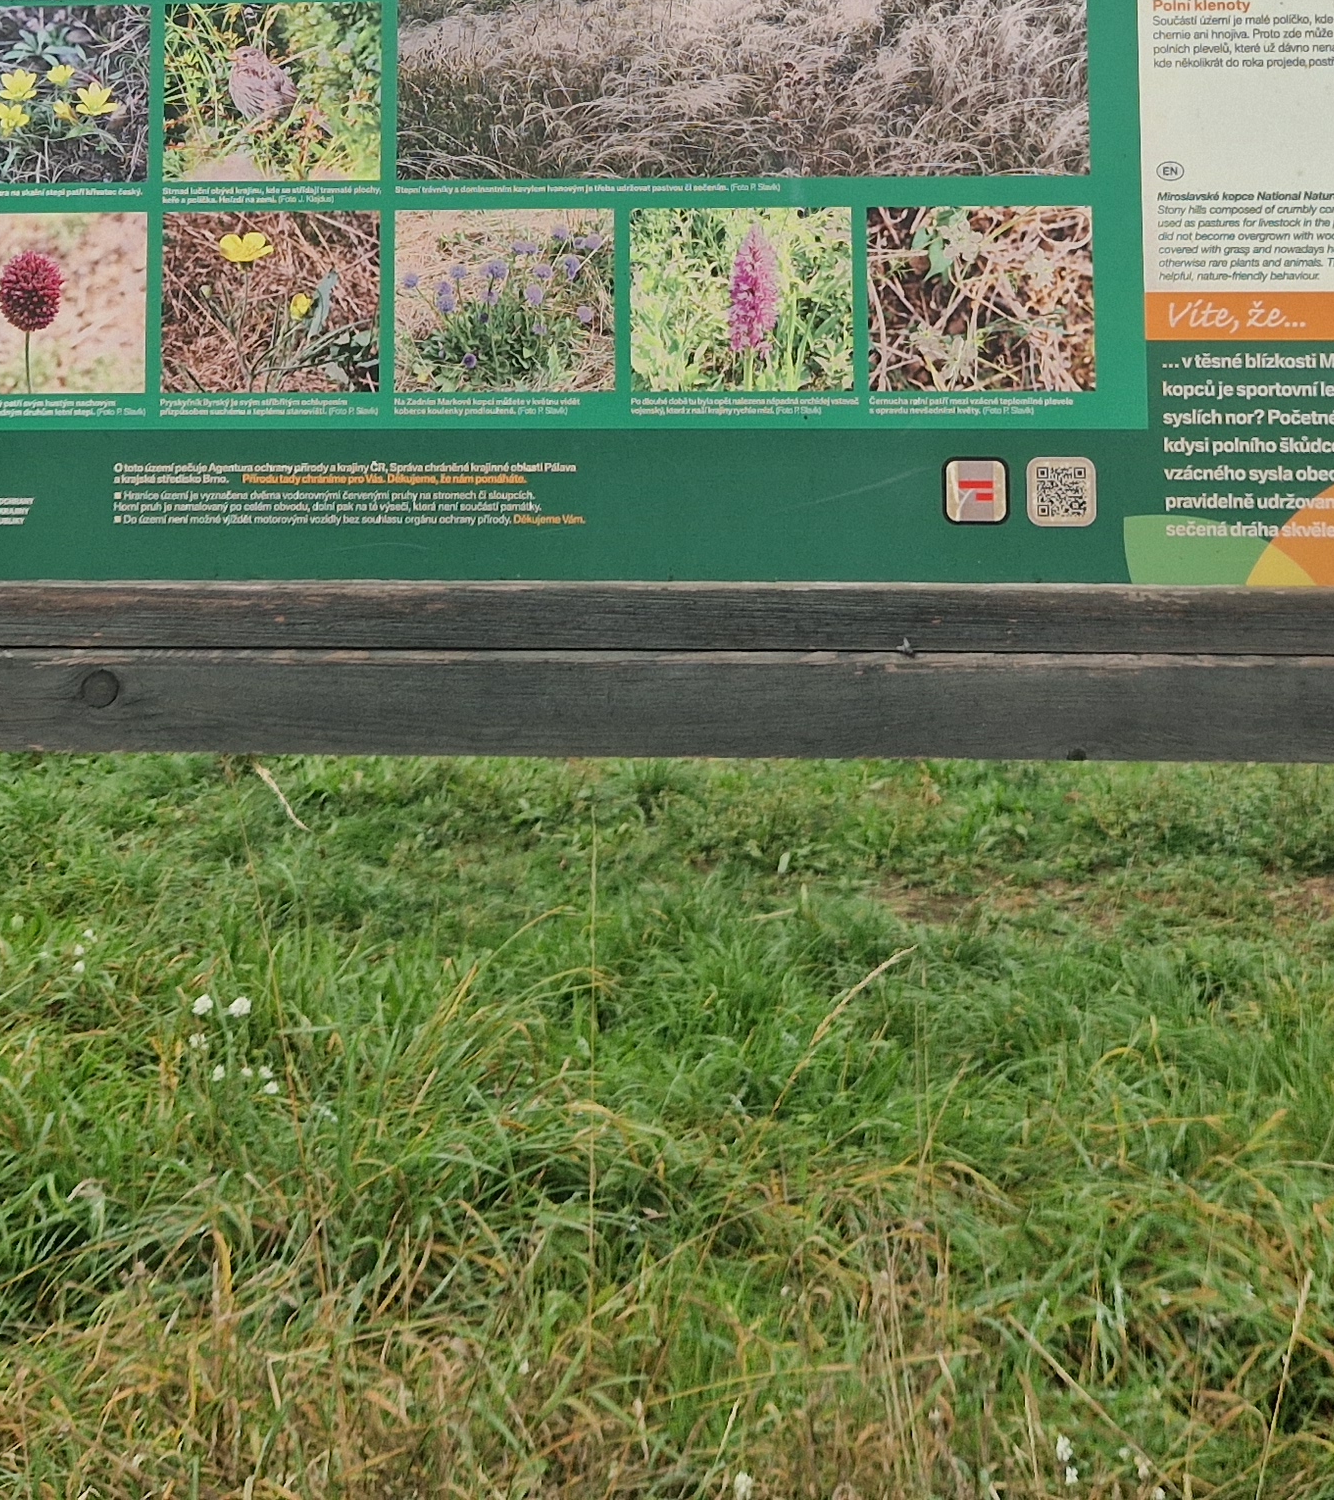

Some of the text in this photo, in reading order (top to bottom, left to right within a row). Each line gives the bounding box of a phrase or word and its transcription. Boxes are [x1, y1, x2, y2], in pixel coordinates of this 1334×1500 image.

[1153, 0, 1250, 13] Polní klenoty
[1152, 15, 1197, 26] Součástí
[1199, 15, 1231, 25] území
[1232, 15, 1242, 27] je
[1245, 14, 1270, 25] malé
[1272, 13, 1312, 26] políčko,
[1314, 13, 1334, 24] kde
[1152, 29, 1191, 39] chemie
[1193, 29, 1208, 39] ani
[1211, 28, 1249, 41] hnojiva.
[1252, 28, 1280, 38] Proto
[1283, 27, 1302, 38] zde
[1304, 27, 1333, 38] může
[1162, 167, 1178, 176] EN
[1168, 299, 1240, 333] Víte,
[1181, 356, 1192, 368] v
[1194, 352, 1242, 368] těsné
[1245, 353, 1316, 368] blízkosti
[1162, 380, 1215, 399] kopců
[1216, 380, 1234, 399] je
[1236, 381, 1319, 399] sportovní
[1162, 408, 1222, 427] syslích
[1225, 408, 1265, 424] nor?
[1163, 436, 1209, 455] kdysi
[1211, 436, 1277, 455] polního
[1163, 464, 1246, 480] vzácného
[1248, 465, 1293, 484] sysla
[1165, 492, 1254, 510] pravidelně
[1165, 520, 1229, 537] sečená
[1228, 521, 1279, 537] dráha
